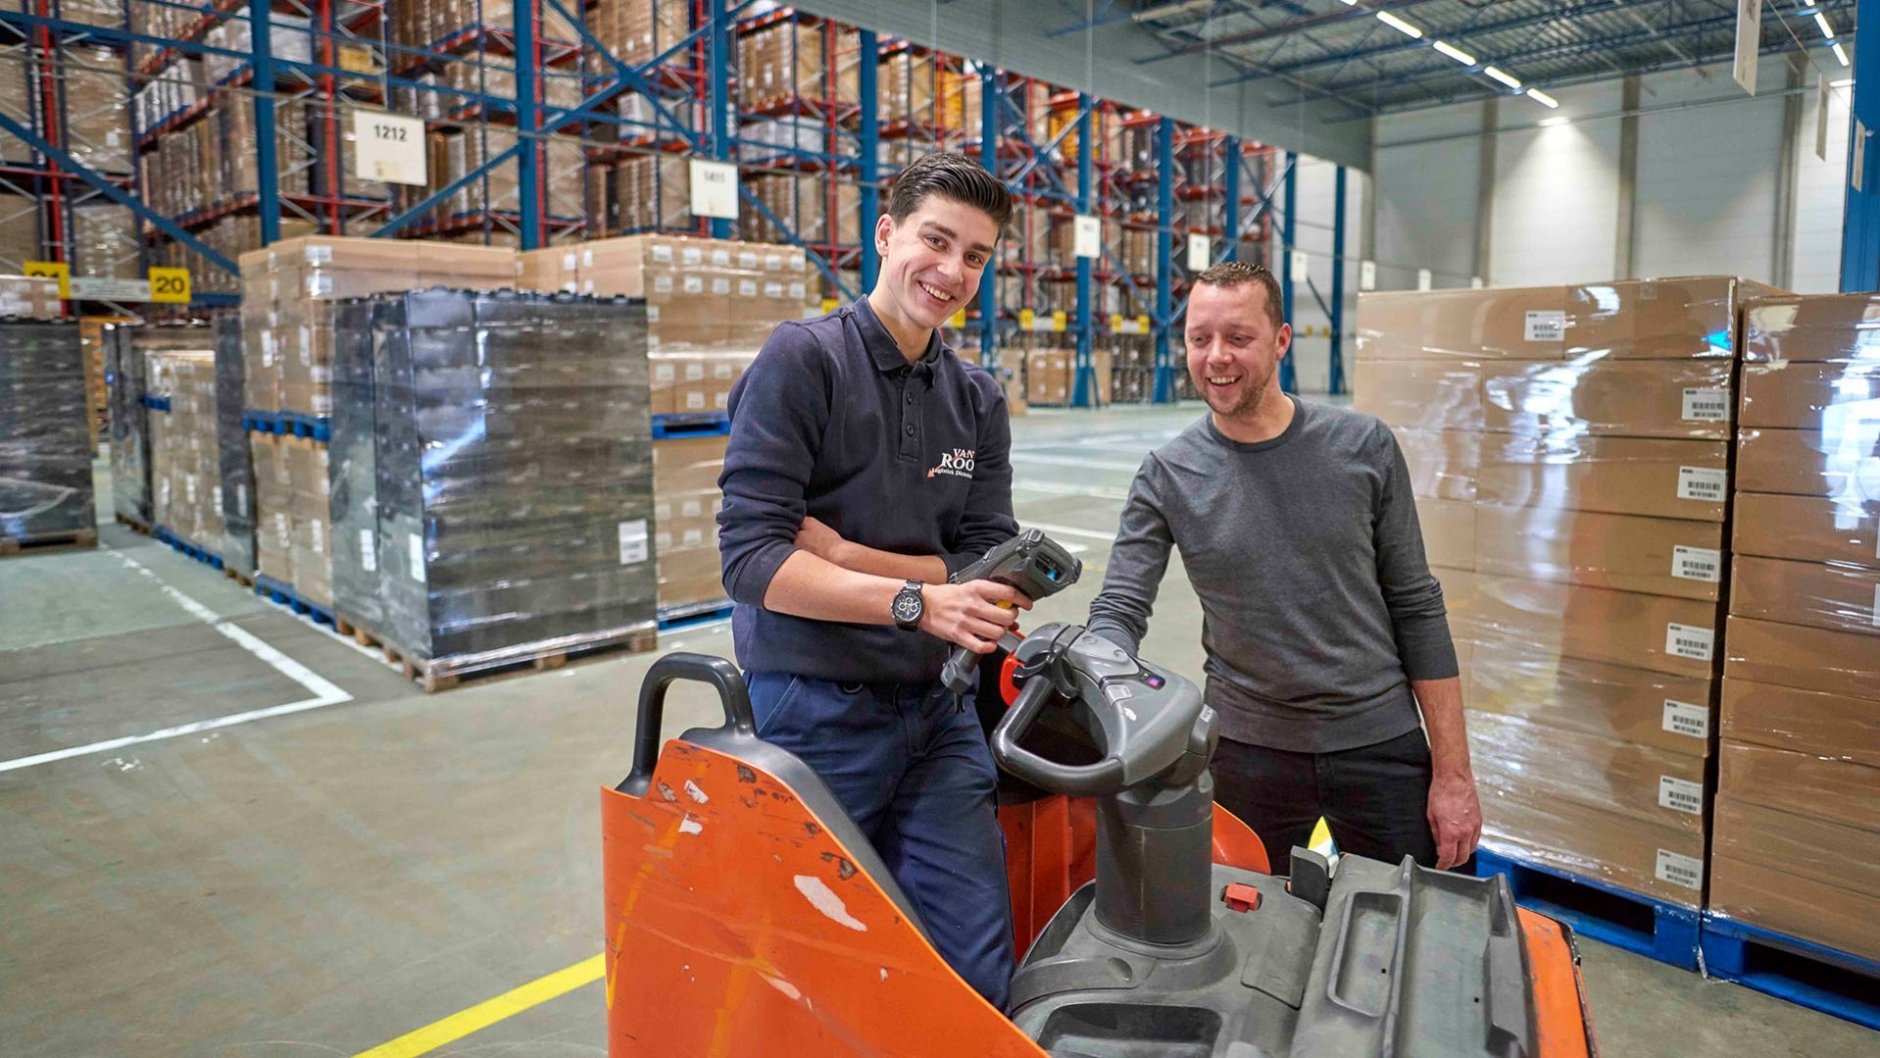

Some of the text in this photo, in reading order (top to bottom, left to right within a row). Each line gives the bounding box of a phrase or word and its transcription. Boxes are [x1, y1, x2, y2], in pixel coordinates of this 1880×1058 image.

[374, 124, 407, 142] 1212
[155, 276, 185, 294] 20
[953, 448, 976, 459] VAN
